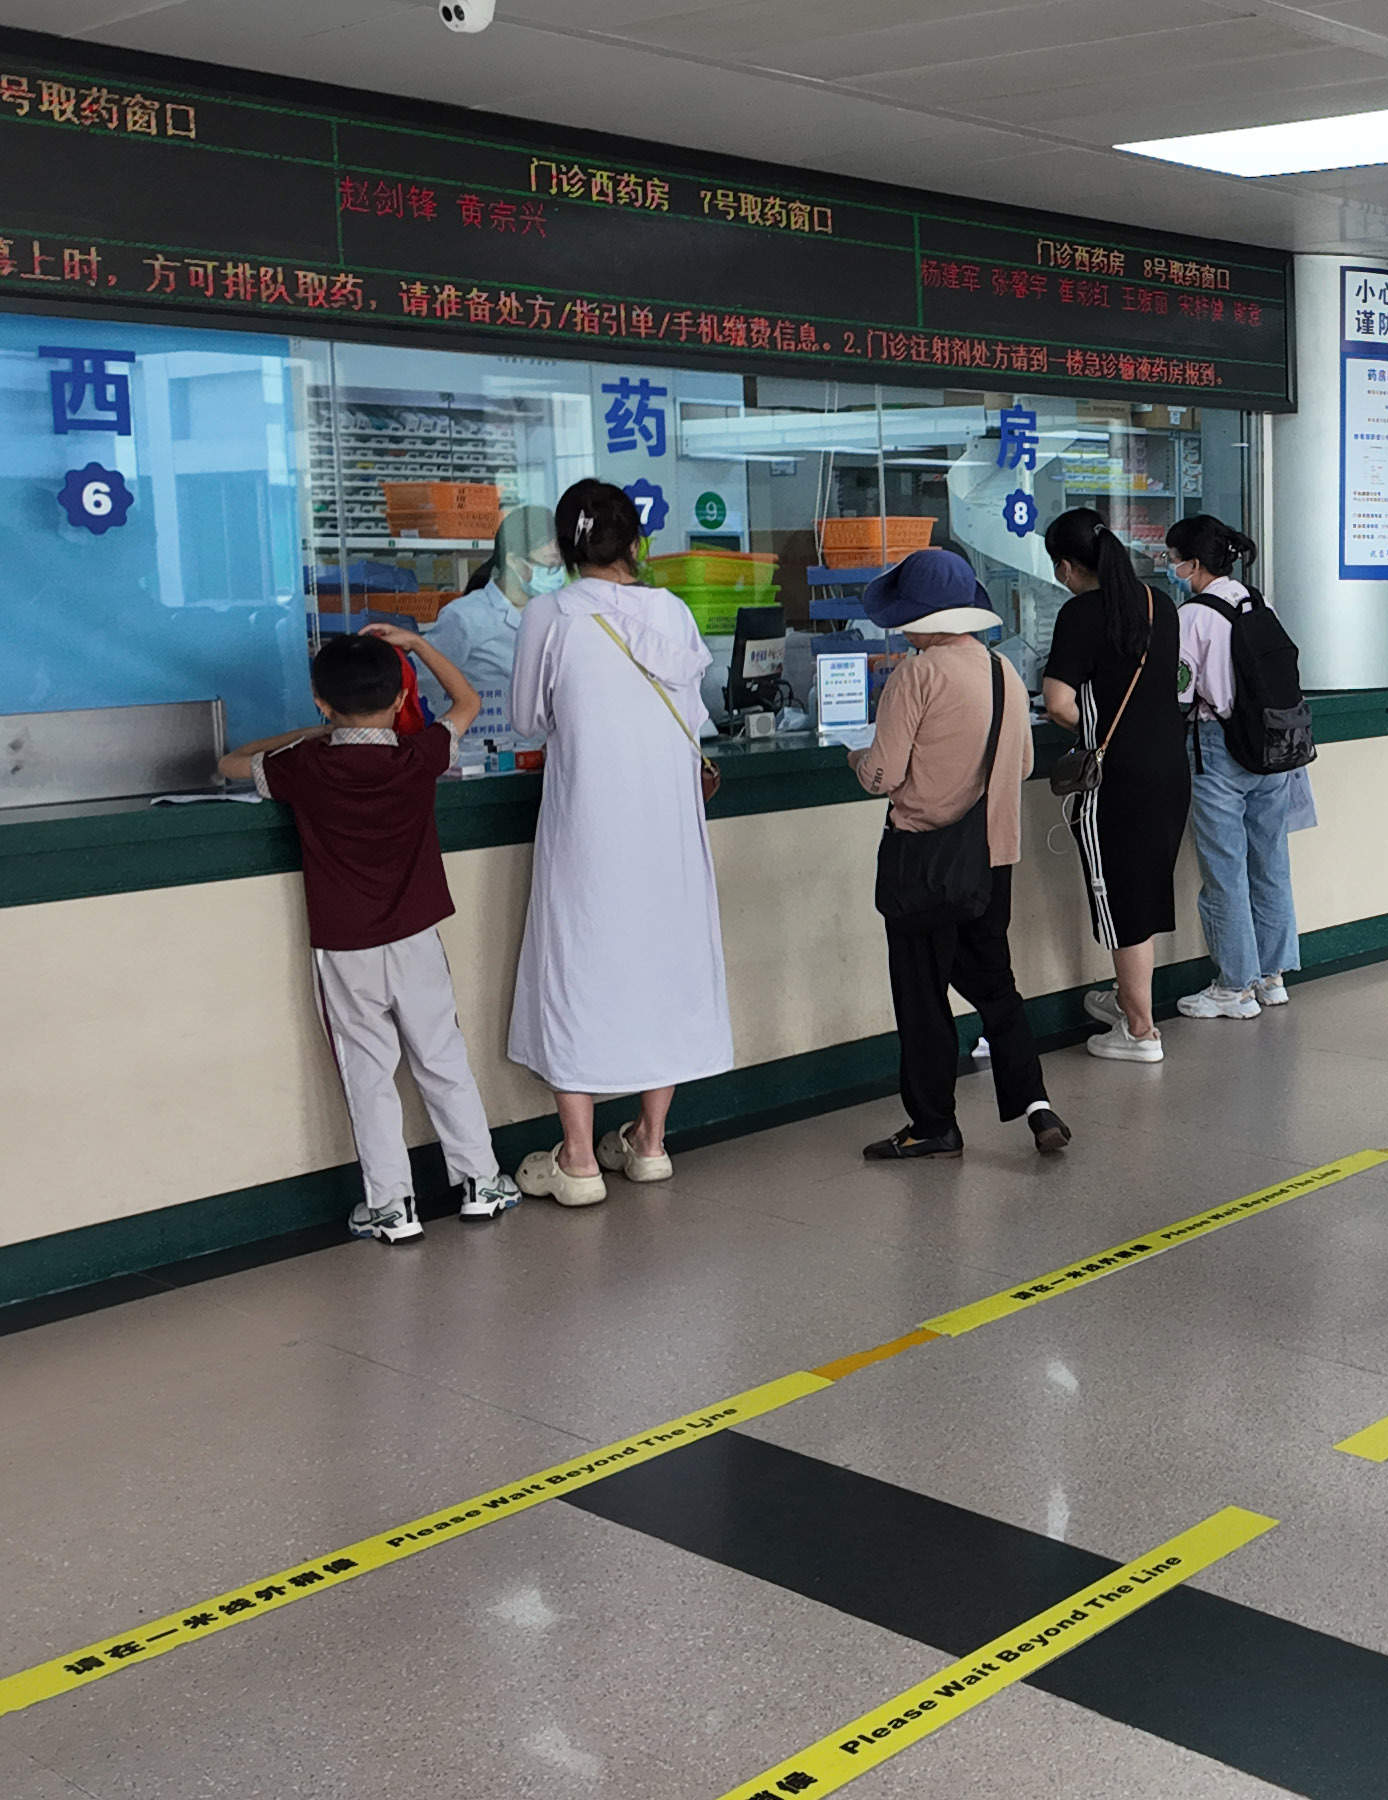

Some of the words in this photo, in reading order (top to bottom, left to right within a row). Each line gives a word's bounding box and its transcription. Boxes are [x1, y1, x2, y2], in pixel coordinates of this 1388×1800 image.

[0, 74, 196, 139] 号取药窗口
[339, 176, 438, 221] 赵剑锋
[456, 194, 548, 239] 黄宗兴
[531, 157, 669, 212] 门诊西药房
[700, 190, 833, 234] 7号取药窗口
[1037, 239, 1125, 276] 门诊西药房
[1143, 258, 1230, 291] 8号取药窗口
[38, 345, 136, 436] 西
[601, 376, 668, 458] 药
[996, 404, 1039, 471] 房
[82, 481, 113, 515] 6
[634, 496, 654, 525] 7
[1013, 502, 1028, 525] 8
[1160, 1219, 1211, 1240] Please
[1207, 1207, 1243, 1221] Wait
[1240, 1187, 1290, 1209] Beyond
[386, 1507, 482, 1548] Please
[482, 1483, 545, 1510] Wait
[544, 1446, 639, 1485] Beyond
[637, 1426, 686, 1448] The
[687, 1407, 738, 1429] Line
[840, 1697, 938, 1756] Please
[934, 1661, 1001, 1700] Wait
[995, 1609, 1085, 1665] Beyond
[1085, 1582, 1133, 1611] The
[1131, 1553, 1182, 1585] Line
